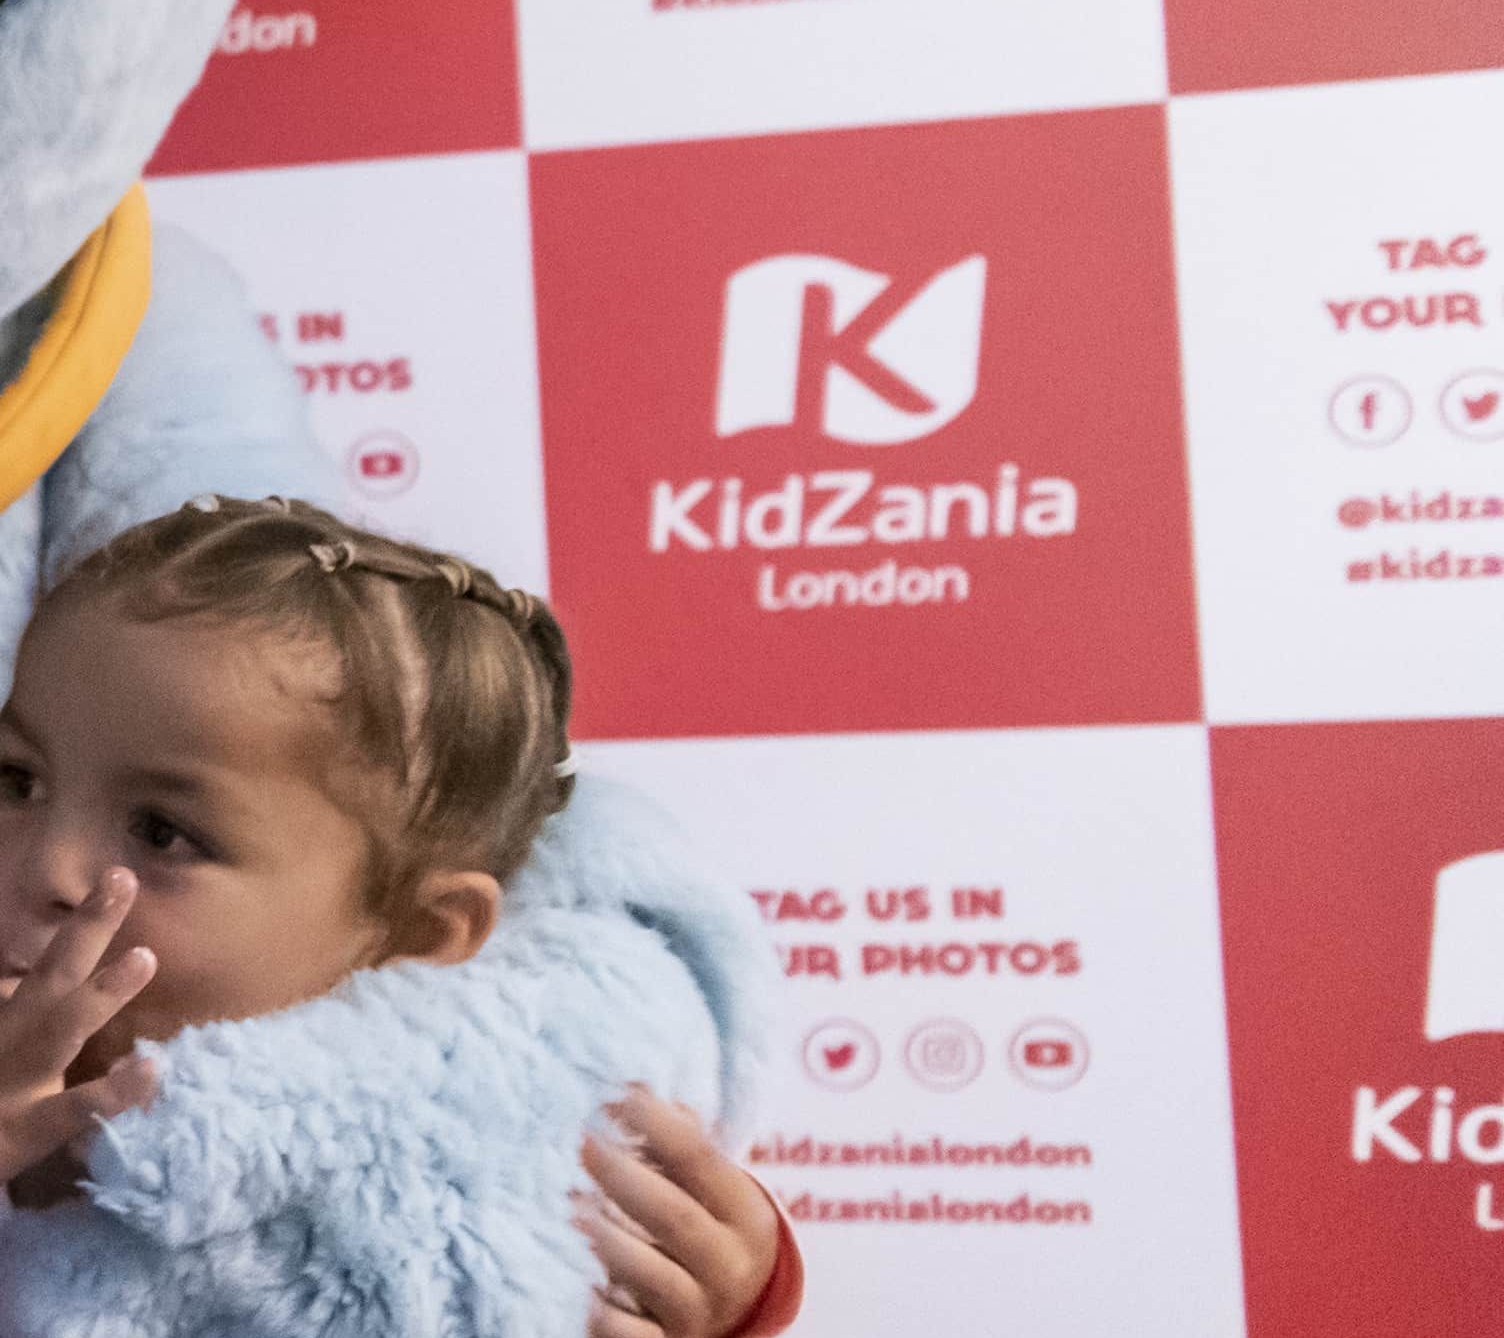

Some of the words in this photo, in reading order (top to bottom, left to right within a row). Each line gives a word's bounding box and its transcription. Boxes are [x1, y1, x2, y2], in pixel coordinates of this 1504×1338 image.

[1378, 234, 1487, 272] TAG
[297, 312, 345, 343] IN
[1325, 292, 1483, 332] YOUR
[648, 463, 1078, 552] KidZania
[757, 561, 970, 611] London
[749, 889, 845, 923] TAG
[865, 887, 931, 922] US
[951, 887, 1004, 919] IN
[860, 940, 1081, 977] PHOTOS
